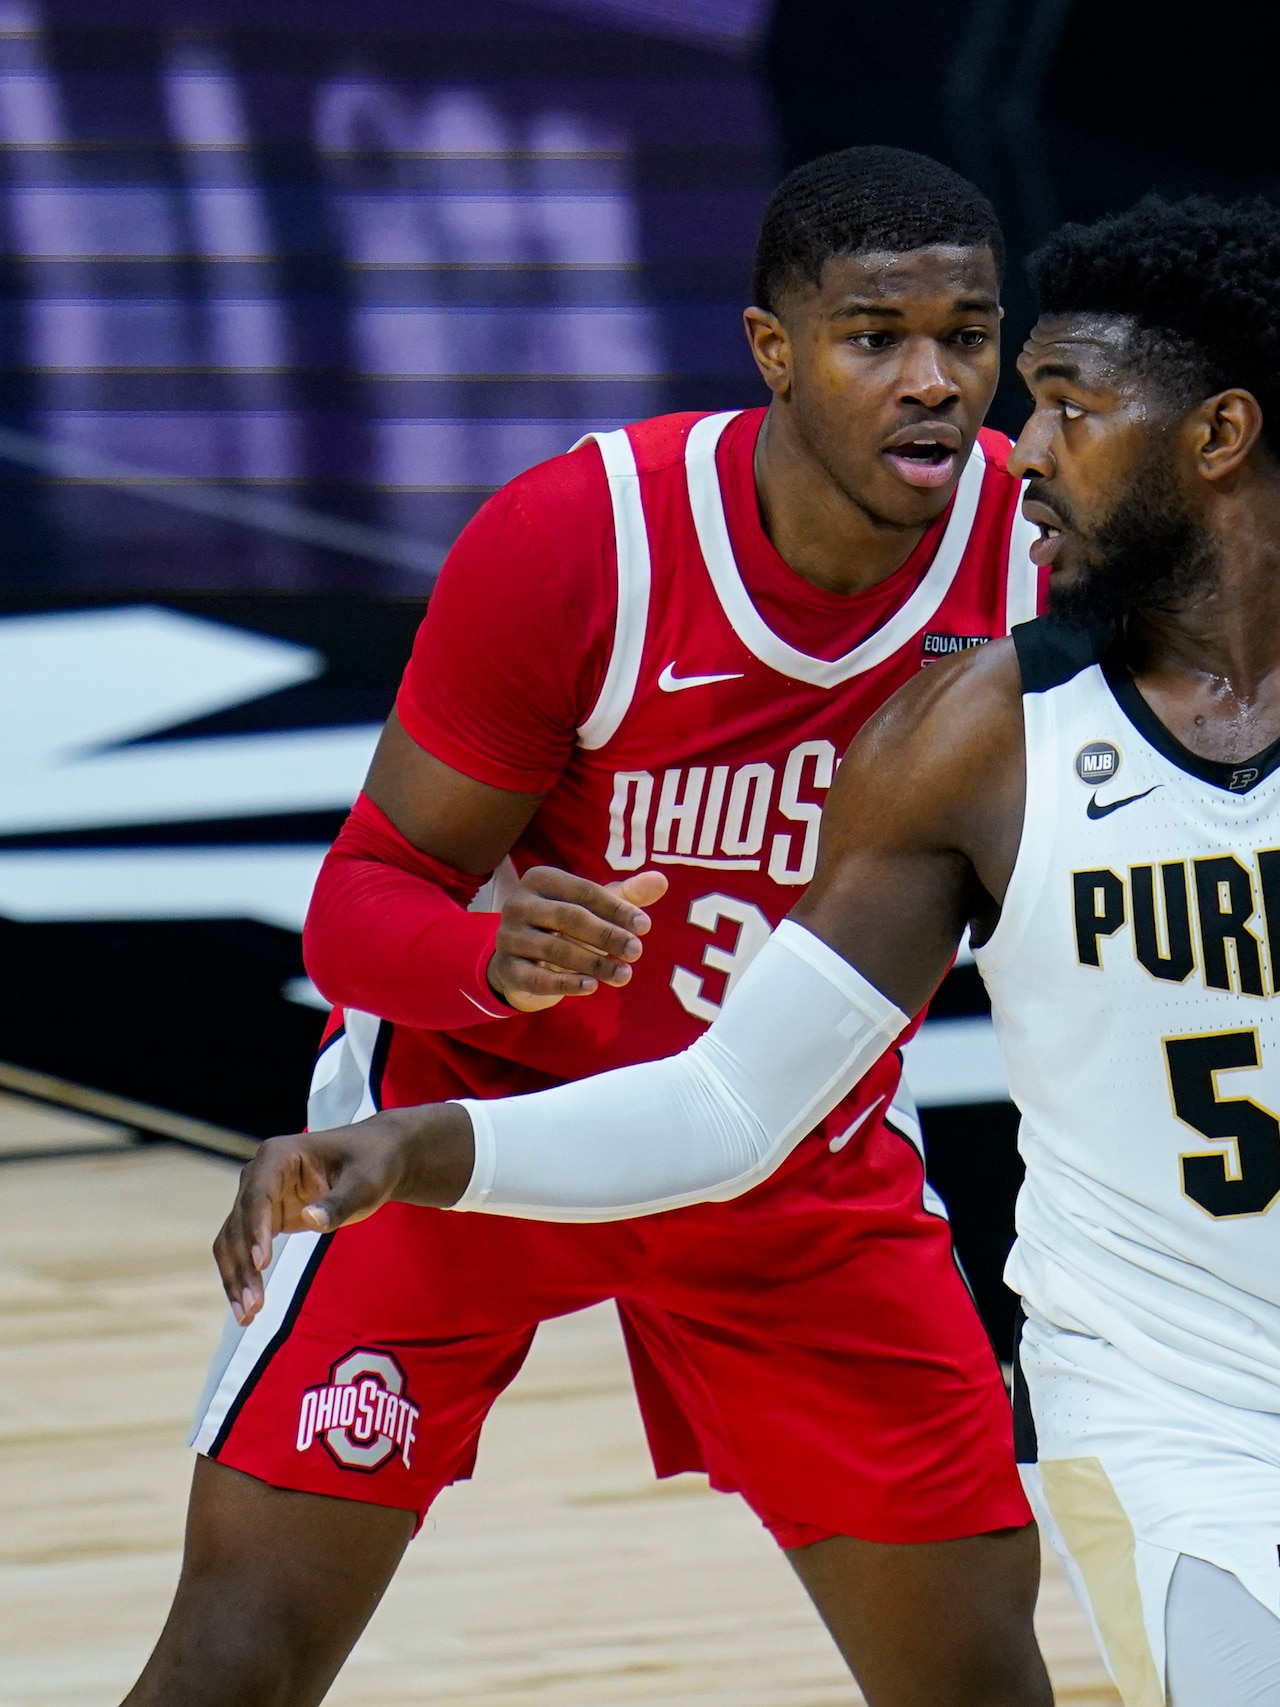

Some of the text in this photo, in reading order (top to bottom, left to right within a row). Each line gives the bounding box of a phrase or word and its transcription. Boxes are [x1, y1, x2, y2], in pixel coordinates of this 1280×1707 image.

[1083, 753, 1112, 772] MJB
[1229, 768, 1259, 790] P
[669, 893, 774, 1023] 3
